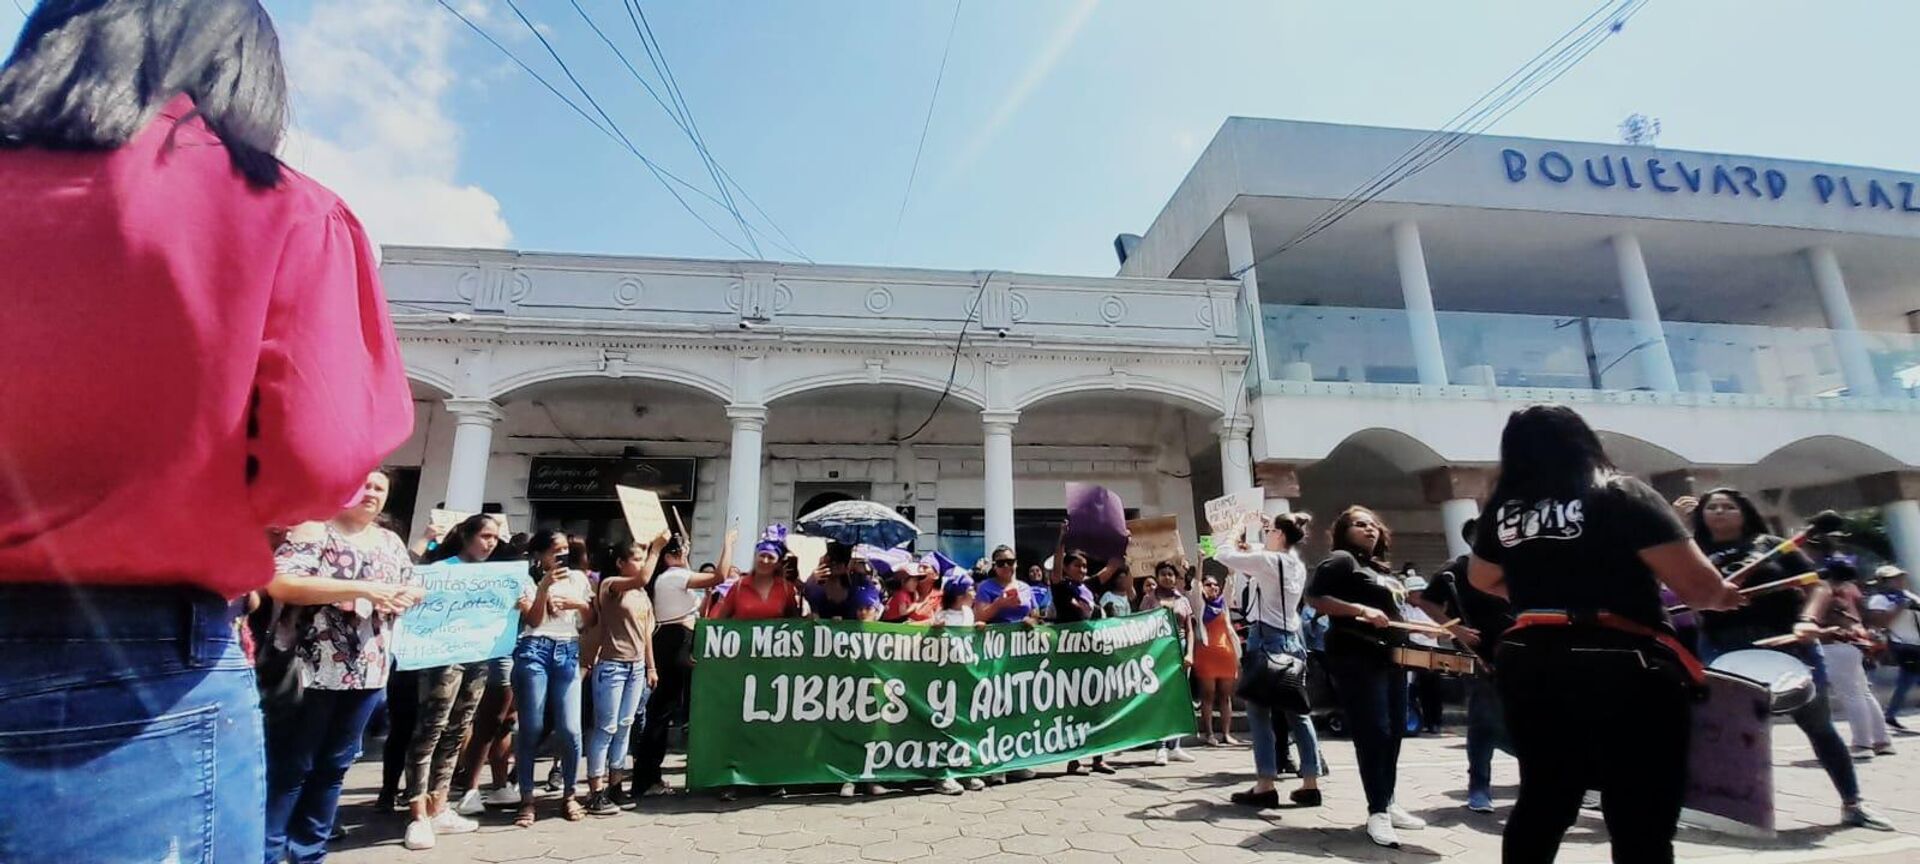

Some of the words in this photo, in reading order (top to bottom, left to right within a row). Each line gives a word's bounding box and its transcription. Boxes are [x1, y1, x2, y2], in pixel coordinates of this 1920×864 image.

[1502, 148, 1788, 199] BOULEVARD
[703, 625, 741, 658] No
[750, 624, 804, 658] Más
[812, 625, 979, 667] Desventajas,
[983, 630, 1006, 659] No
[742, 674, 909, 724] LIBRES
[969, 654, 1160, 723] AUTÓNOMAS
[860, 738, 973, 779] para
[976, 715, 1091, 766] decidir
